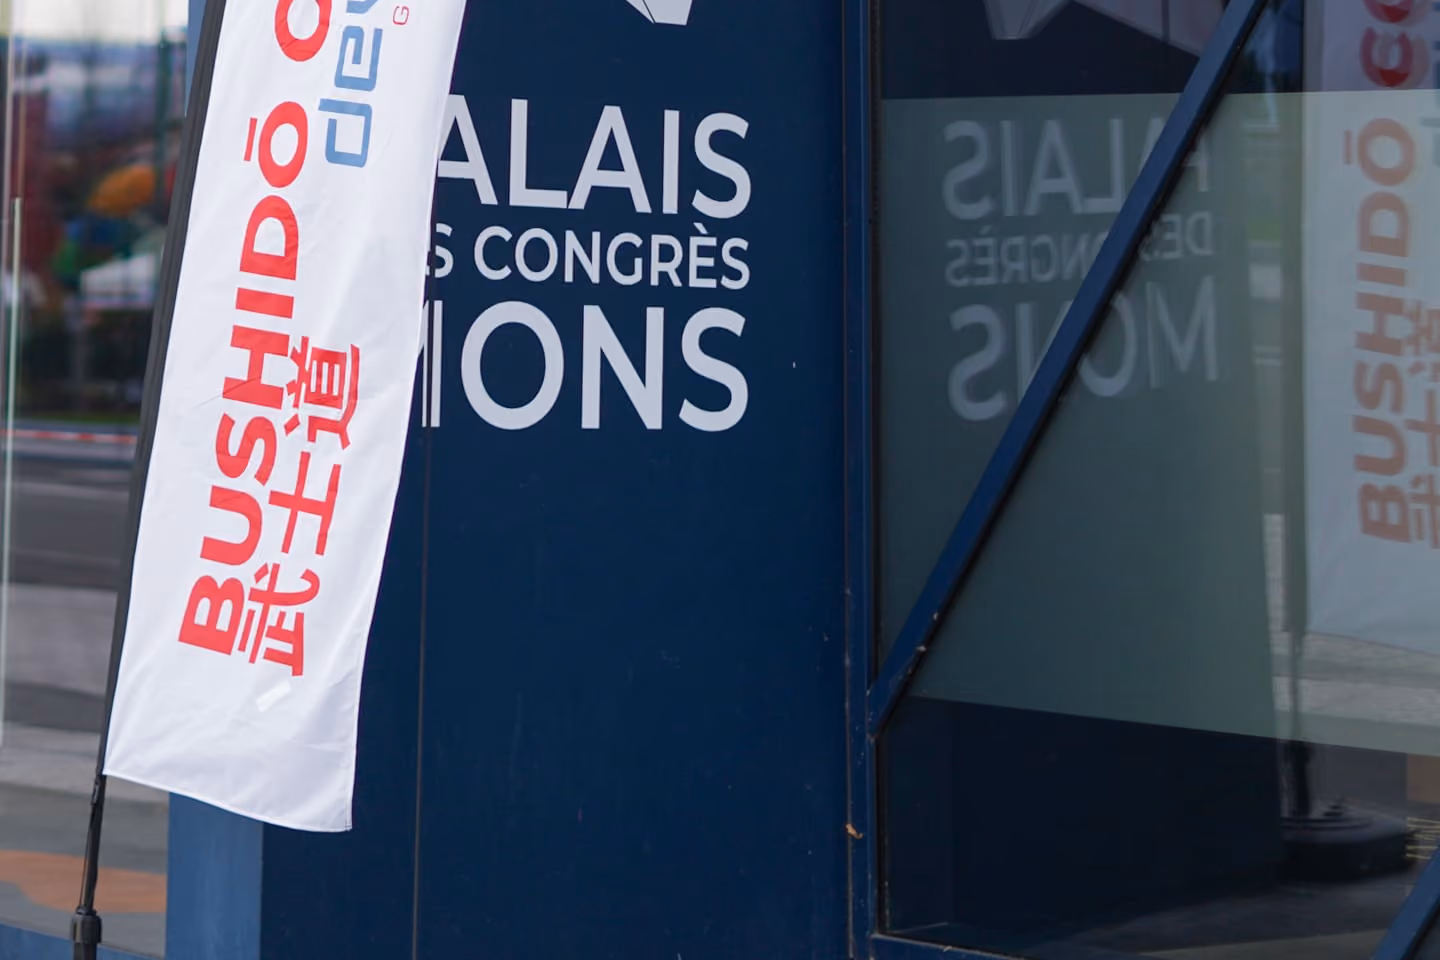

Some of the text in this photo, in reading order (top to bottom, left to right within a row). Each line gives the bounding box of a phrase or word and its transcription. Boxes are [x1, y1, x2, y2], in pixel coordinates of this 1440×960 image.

[436, 93, 752, 220] ALAIS
[473, 222, 751, 290] CONGRÈS
[178, 101, 309, 656] BUSHIDŌ
[238, 335, 360, 677] 武士道
